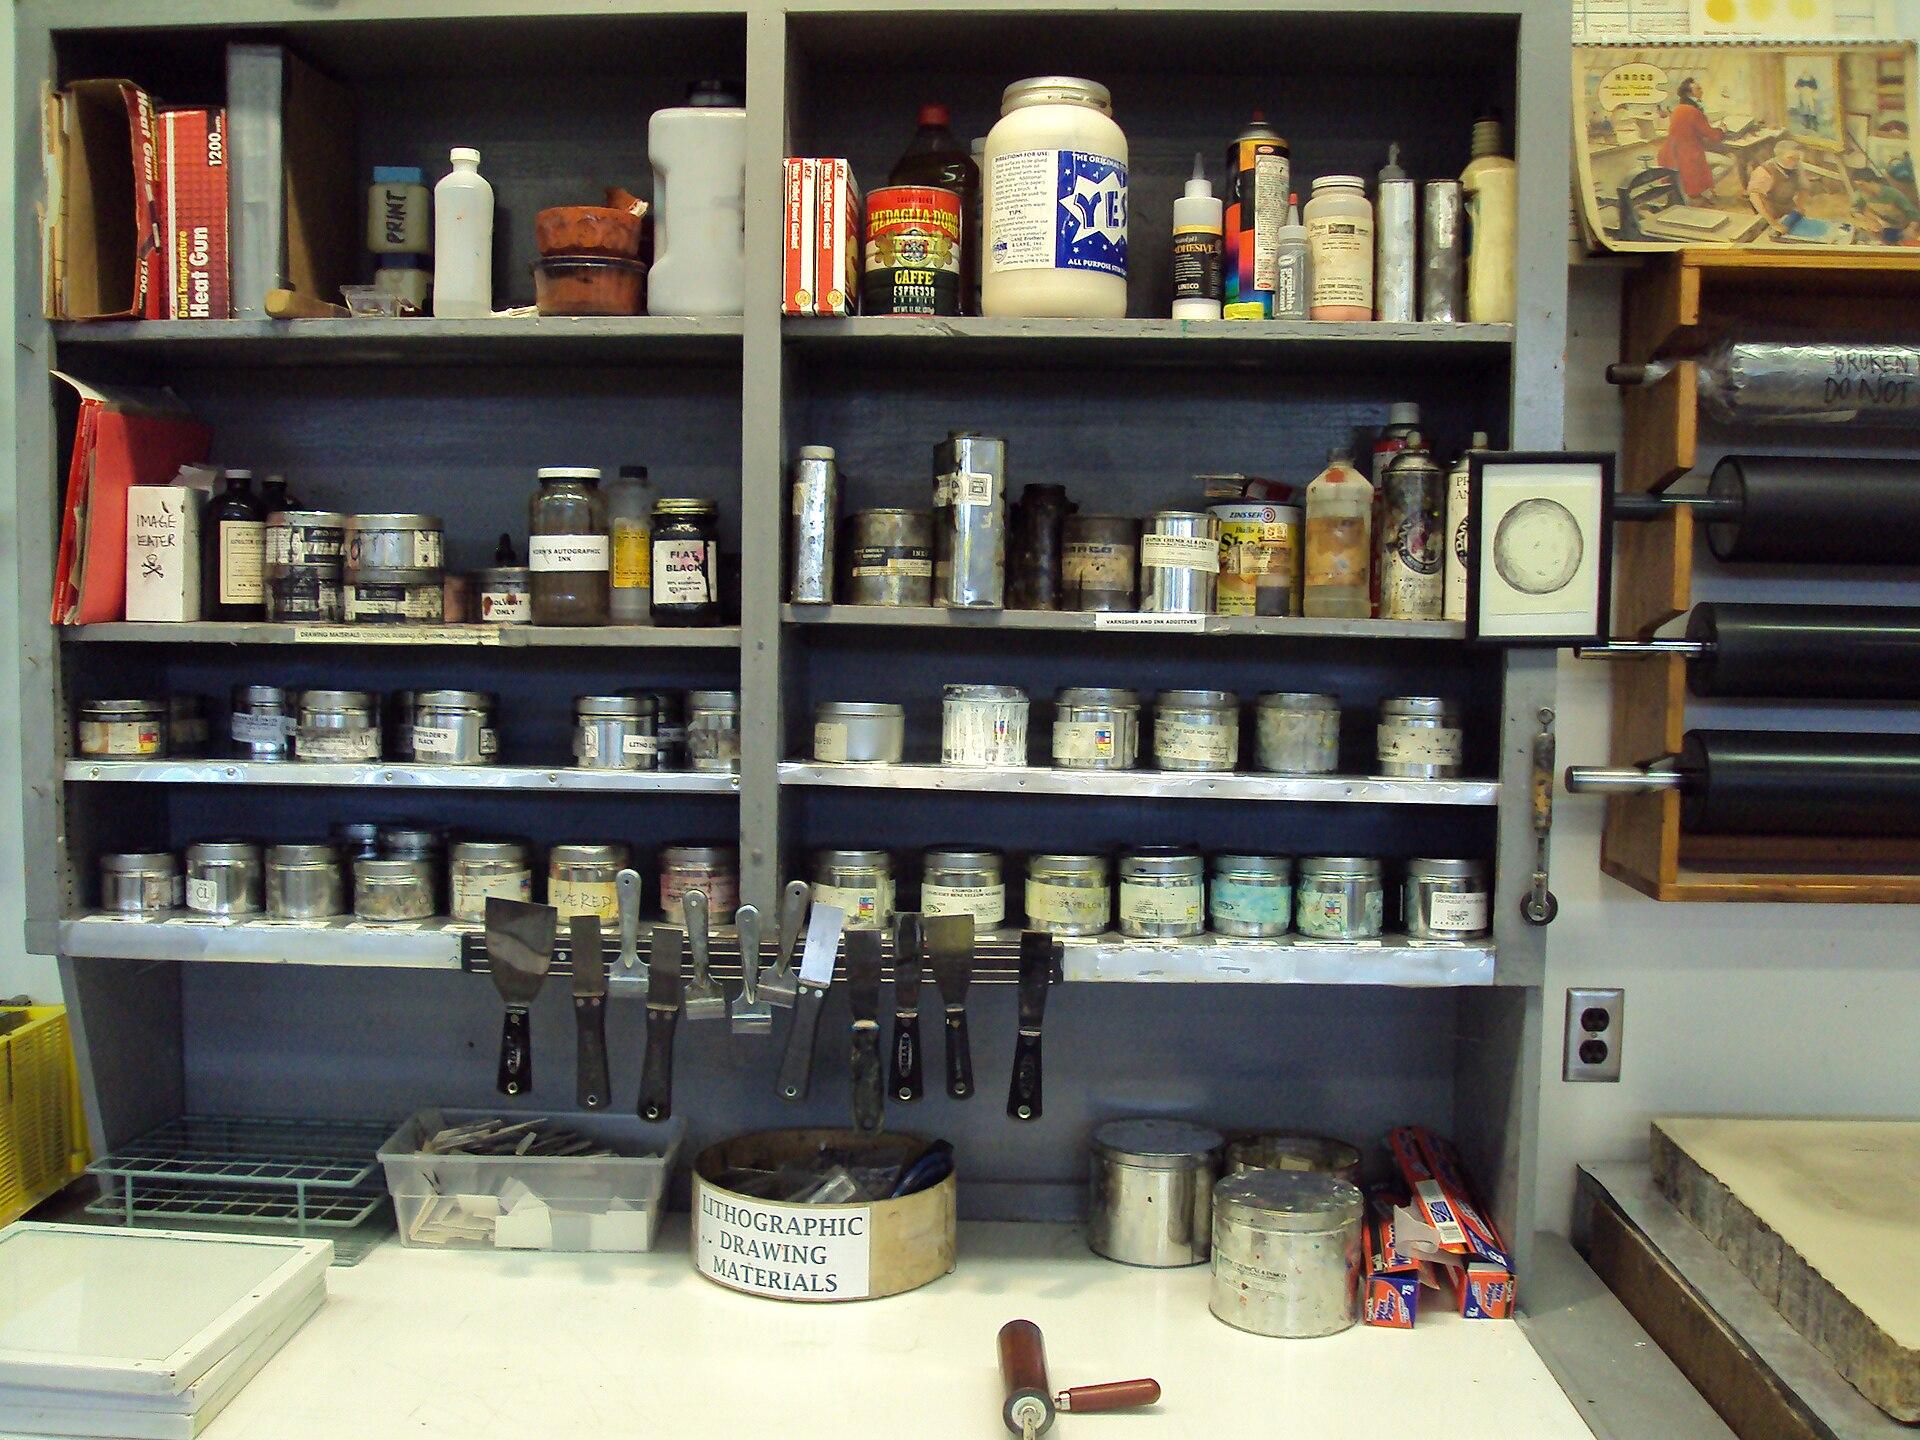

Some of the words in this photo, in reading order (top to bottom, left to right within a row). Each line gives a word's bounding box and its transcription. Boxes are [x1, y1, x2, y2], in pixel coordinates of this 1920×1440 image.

[136, 90, 152, 139] Heat
[142, 143, 154, 182] Gun
[208, 132, 222, 166] 1200
[1072, 153, 1088, 161] THE
[386, 190, 407, 244] PRINT
[871, 208, 930, 238] MEDAGLIA
[1074, 191, 1127, 229] YES
[178, 230, 188, 293] Temperature
[190, 227, 209, 268] Gun
[1068, 258, 1081, 266] ALL
[1083, 260, 1111, 270] PURPOSE
[140, 260, 149, 293] 1200
[893, 286, 935, 297] ESPRESSO
[178, 294, 188, 318] Dual
[190, 275, 209, 318] Heat
[1833, 352, 1909, 374] BROKEN
[1824, 376, 1849, 403] DO
[1859, 379, 1916, 403] NOT
[136, 514, 178, 530] IMAGE
[137, 534, 176, 548] EATER
[666, 564, 703, 572] BLACK
[702, 1194, 863, 1237] LITHOGRAPHIC
[719, 1230, 827, 1265] DRAWING
[713, 1255, 838, 1293] MATERIALS
